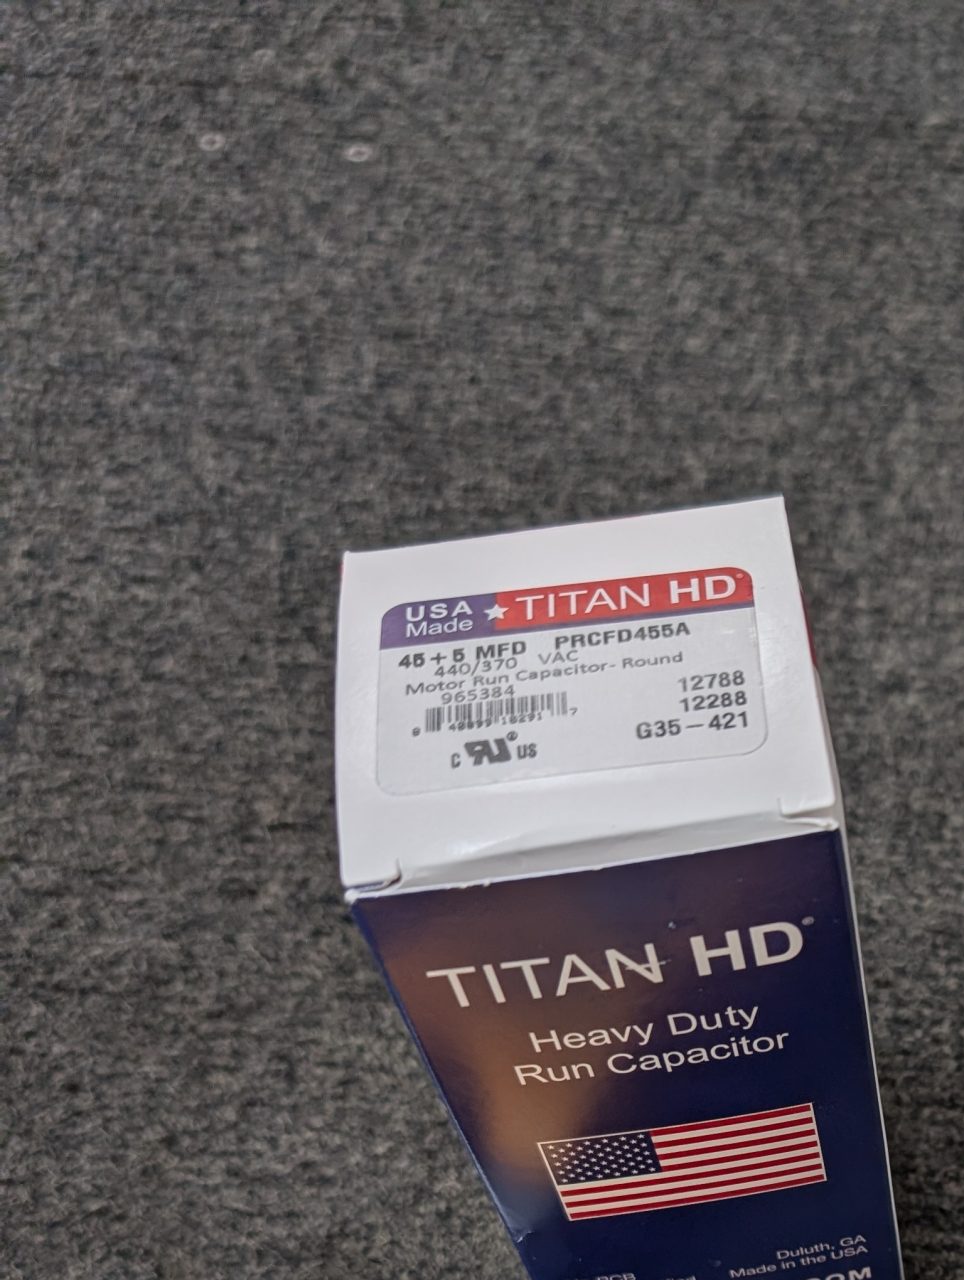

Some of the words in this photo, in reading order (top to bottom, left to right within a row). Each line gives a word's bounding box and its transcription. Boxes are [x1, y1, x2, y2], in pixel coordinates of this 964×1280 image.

[406, 601, 473, 621] USA
[515, 583, 650, 621] TITAN
[669, 575, 736, 604] HD
[405, 619, 473, 638] Made
[476, 641, 526, 660] MFD
[555, 622, 690, 649] PRCFD455A
[406, 680, 465, 696] Motor
[473, 675, 508, 687] Run
[622, 652, 683, 669] Round
[434, 657, 517, 677] 440/370
[538, 651, 578, 665] VAC
[441, 685, 515, 704] 965384
[677, 670, 745, 692] 12788
[680, 691, 747, 712] 12288
[426, 943, 664, 1008] TITAN
[689, 920, 803, 977] HD
[528, 1020, 654, 1054] Heavy
[667, 1005, 758, 1036] Duty
[514, 1061, 595, 1086] Run
[606, 1029, 789, 1075] Capacitor
[840, 1234, 866, 1247] GA
[729, 1263, 776, 1279] Made
[781, 1260, 796, 1270] in
[800, 1255, 826, 1266] the
[831, 1245, 868, 1260] USA
